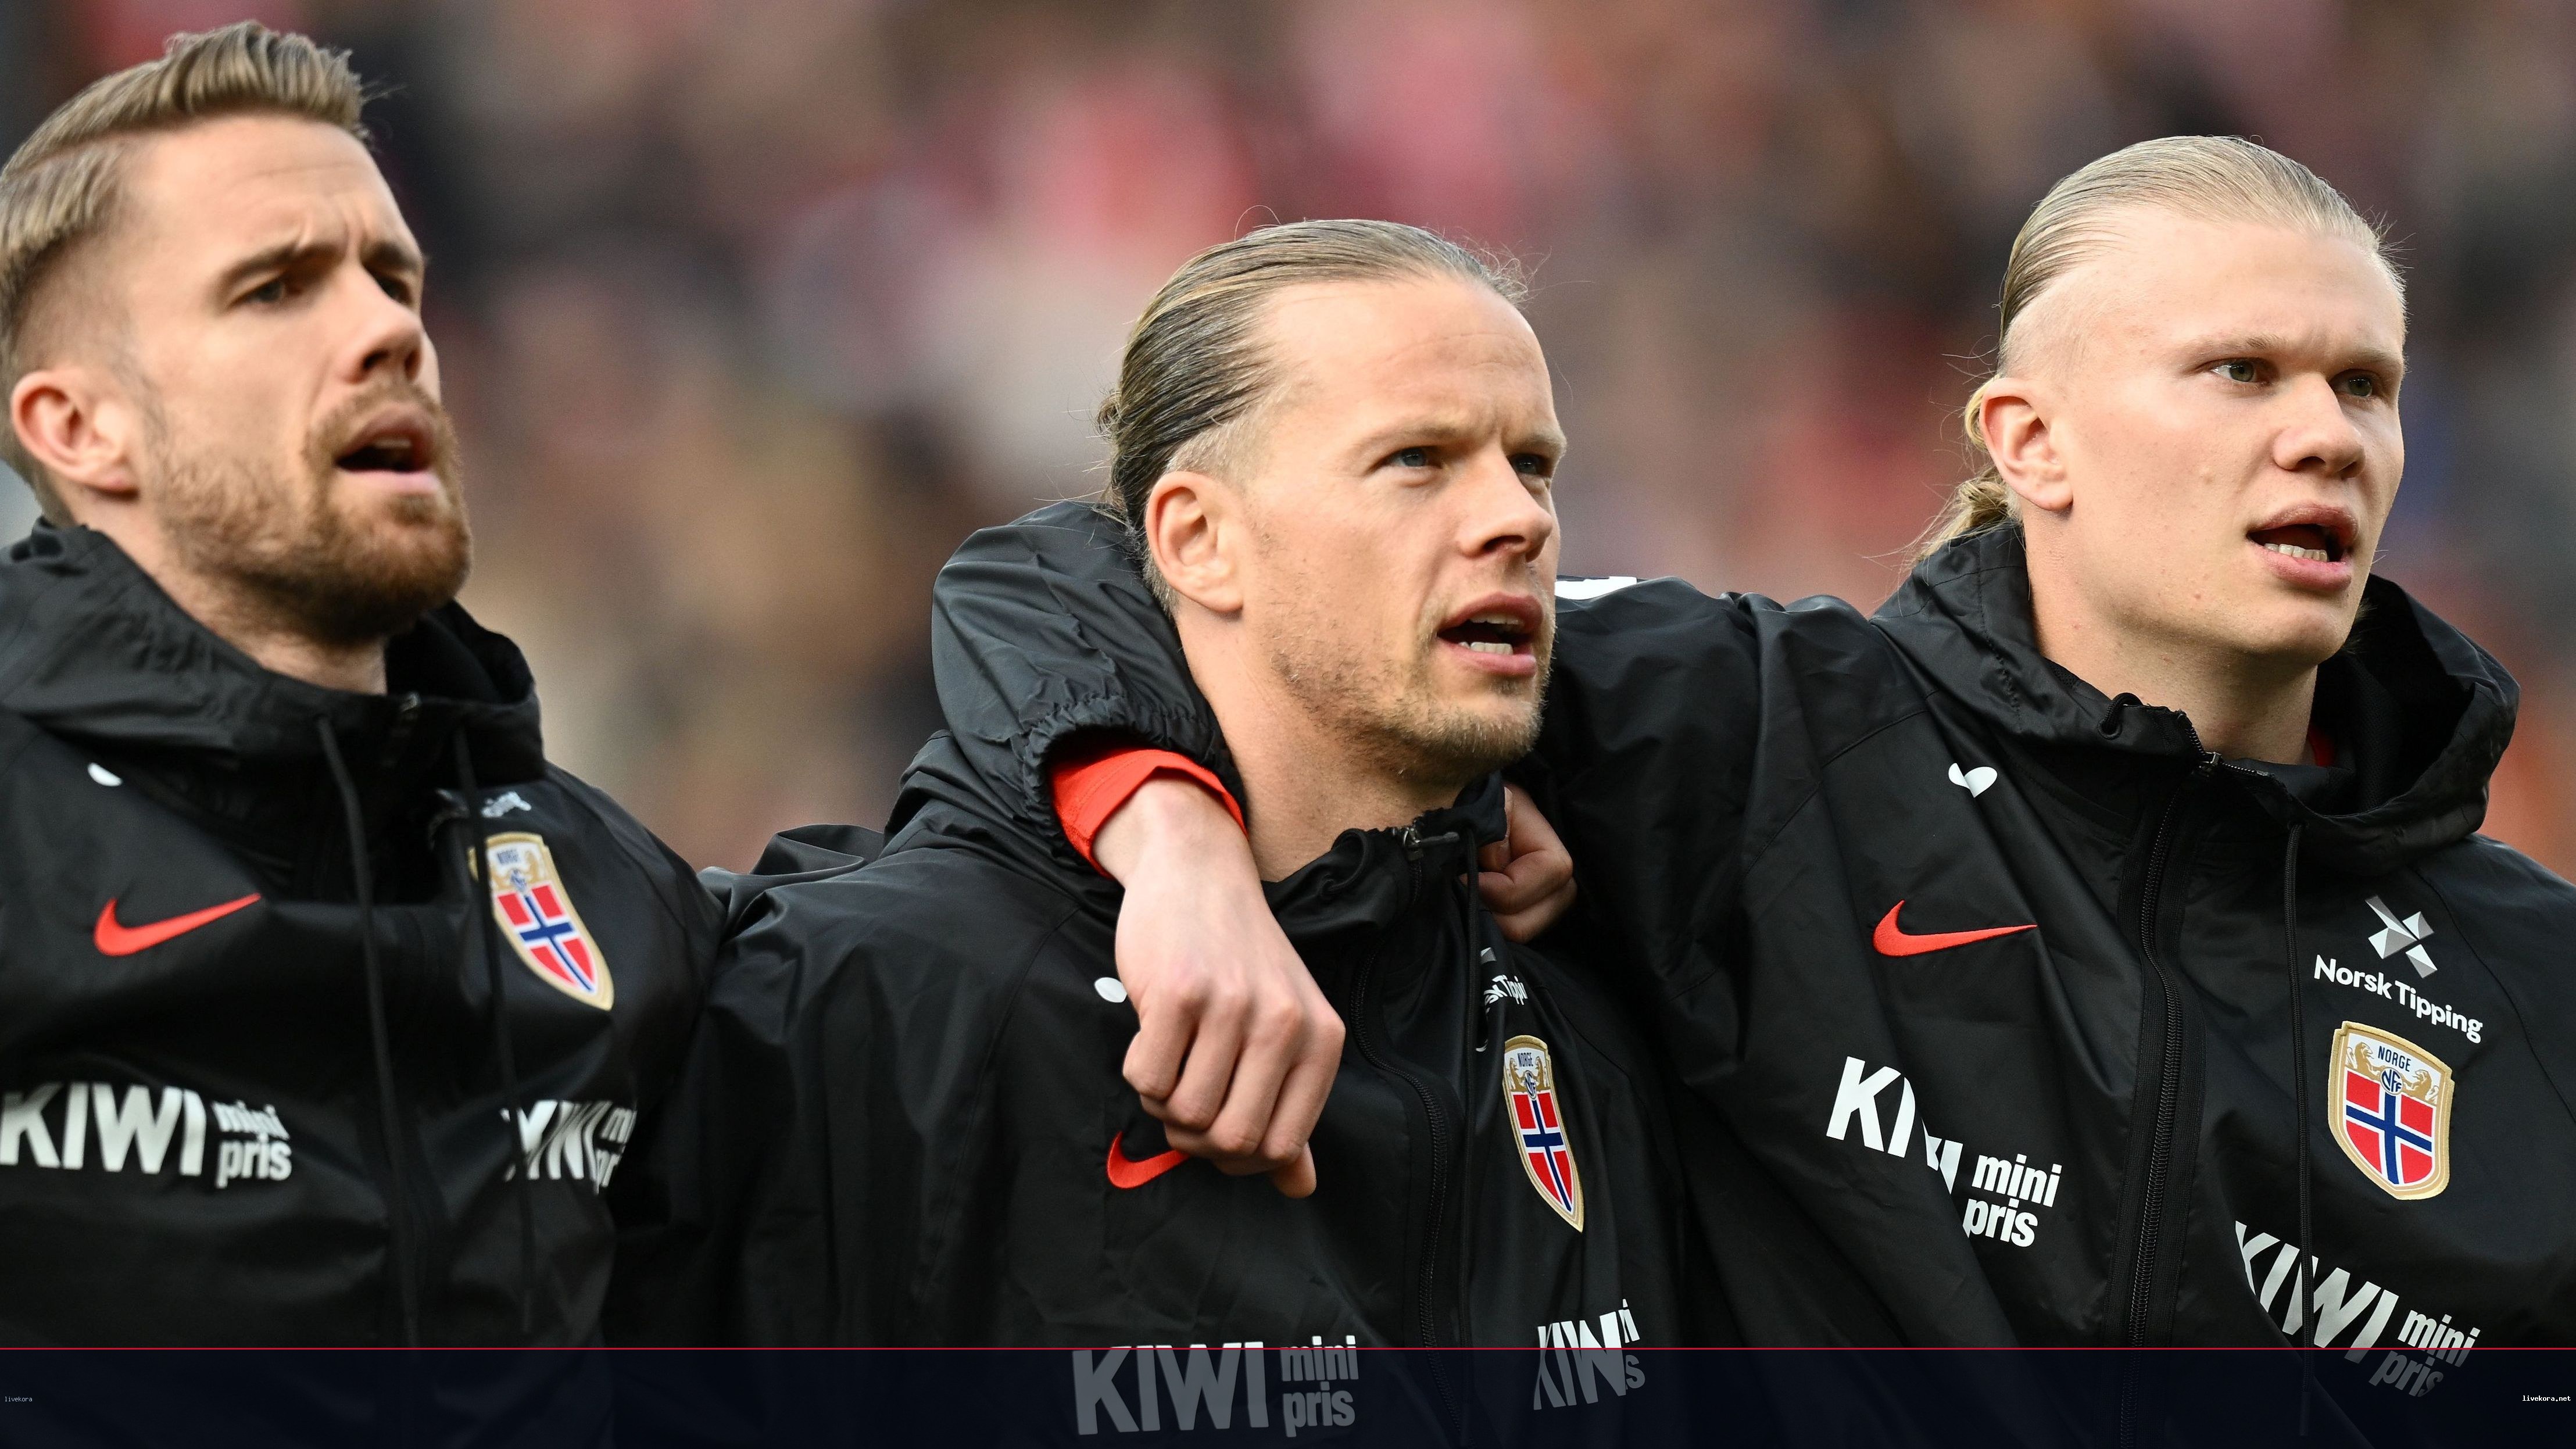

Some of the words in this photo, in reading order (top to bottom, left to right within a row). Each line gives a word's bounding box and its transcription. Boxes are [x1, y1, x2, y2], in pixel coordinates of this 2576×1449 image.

[2314, 954, 2392, 1000] Norsk
[2395, 980, 2483, 1044] Tipping
[2378, 1046, 2412, 1072] NORGE
[0, 1082, 207, 1176] KIWI
[216, 1132, 292, 1189] pris
[1972, 1153, 2062, 1208] mini
[1962, 1197, 2038, 1247] pris
[1280, 1334, 1359, 1382] mini
[1533, 1311, 1627, 1411] KIW
[2397, 1310, 2481, 1368] mini
[1072, 1341, 1269, 1436] KIWI
[2369, 1350, 2444, 1398] pris
[1283, 1381, 1357, 1438] pris
